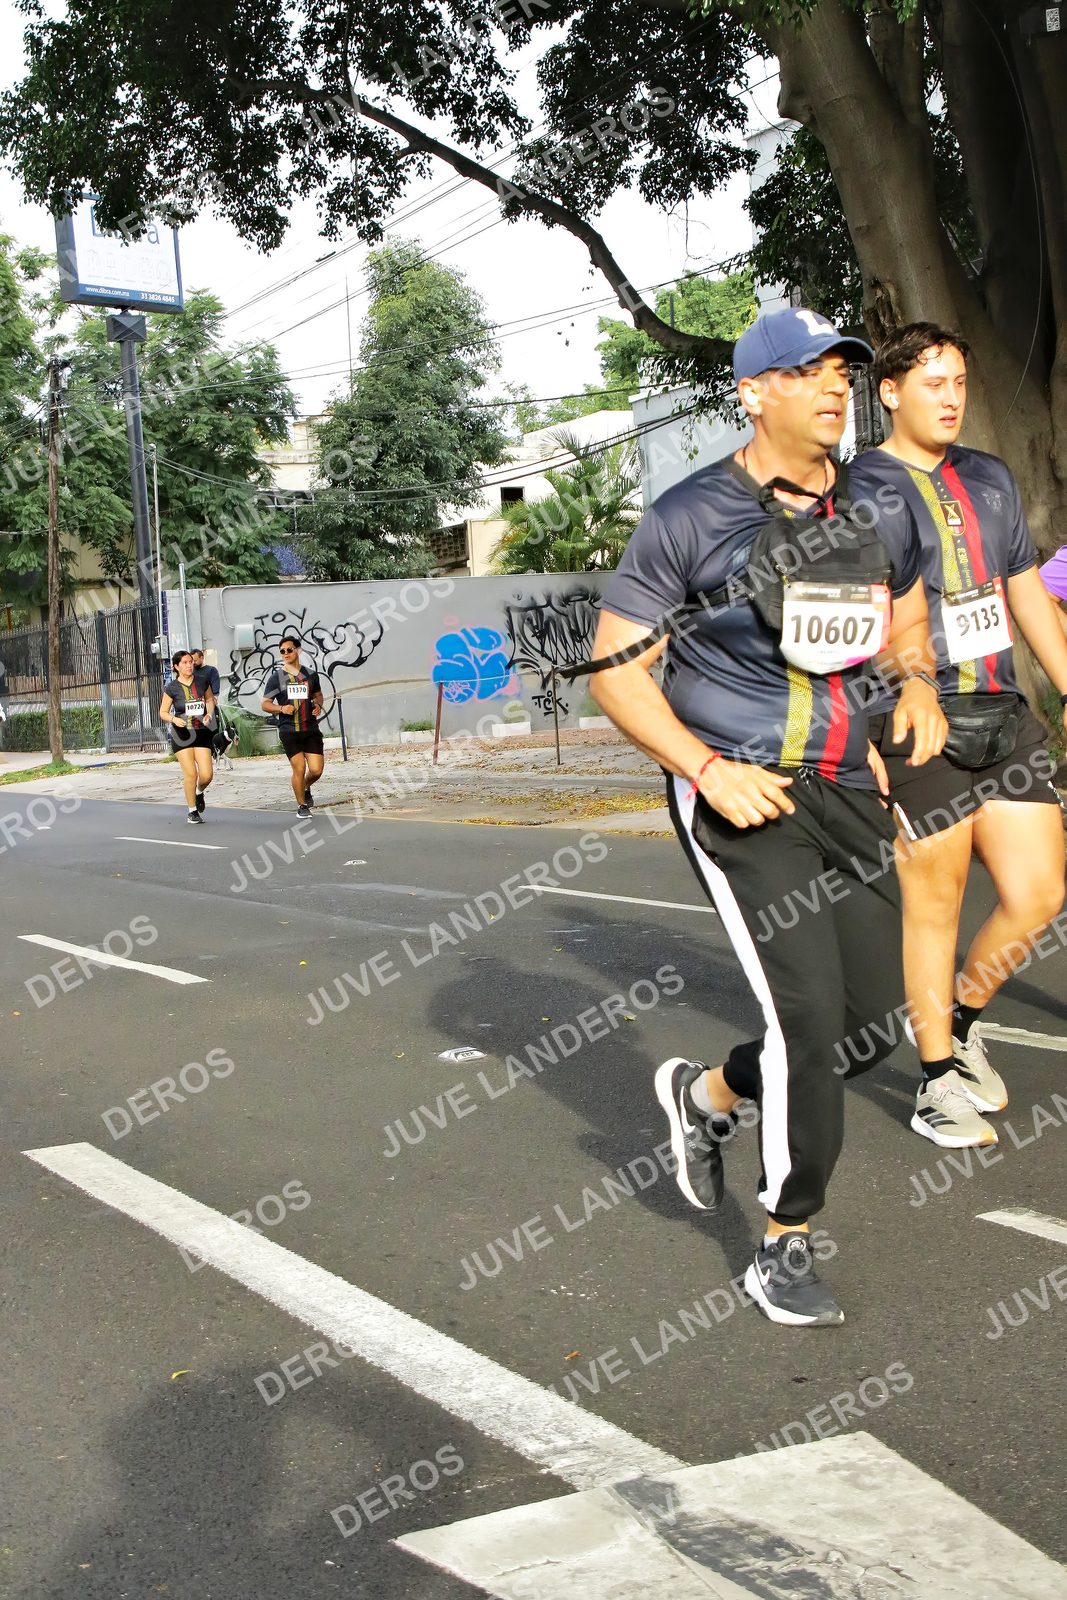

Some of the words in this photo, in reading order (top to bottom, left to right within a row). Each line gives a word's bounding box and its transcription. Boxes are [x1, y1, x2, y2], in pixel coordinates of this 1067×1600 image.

[254, 607, 307, 629] TOY
[791, 614, 876, 646] 10607
[956, 604, 999, 636] 9135
[288, 685, 307, 694] 11370
